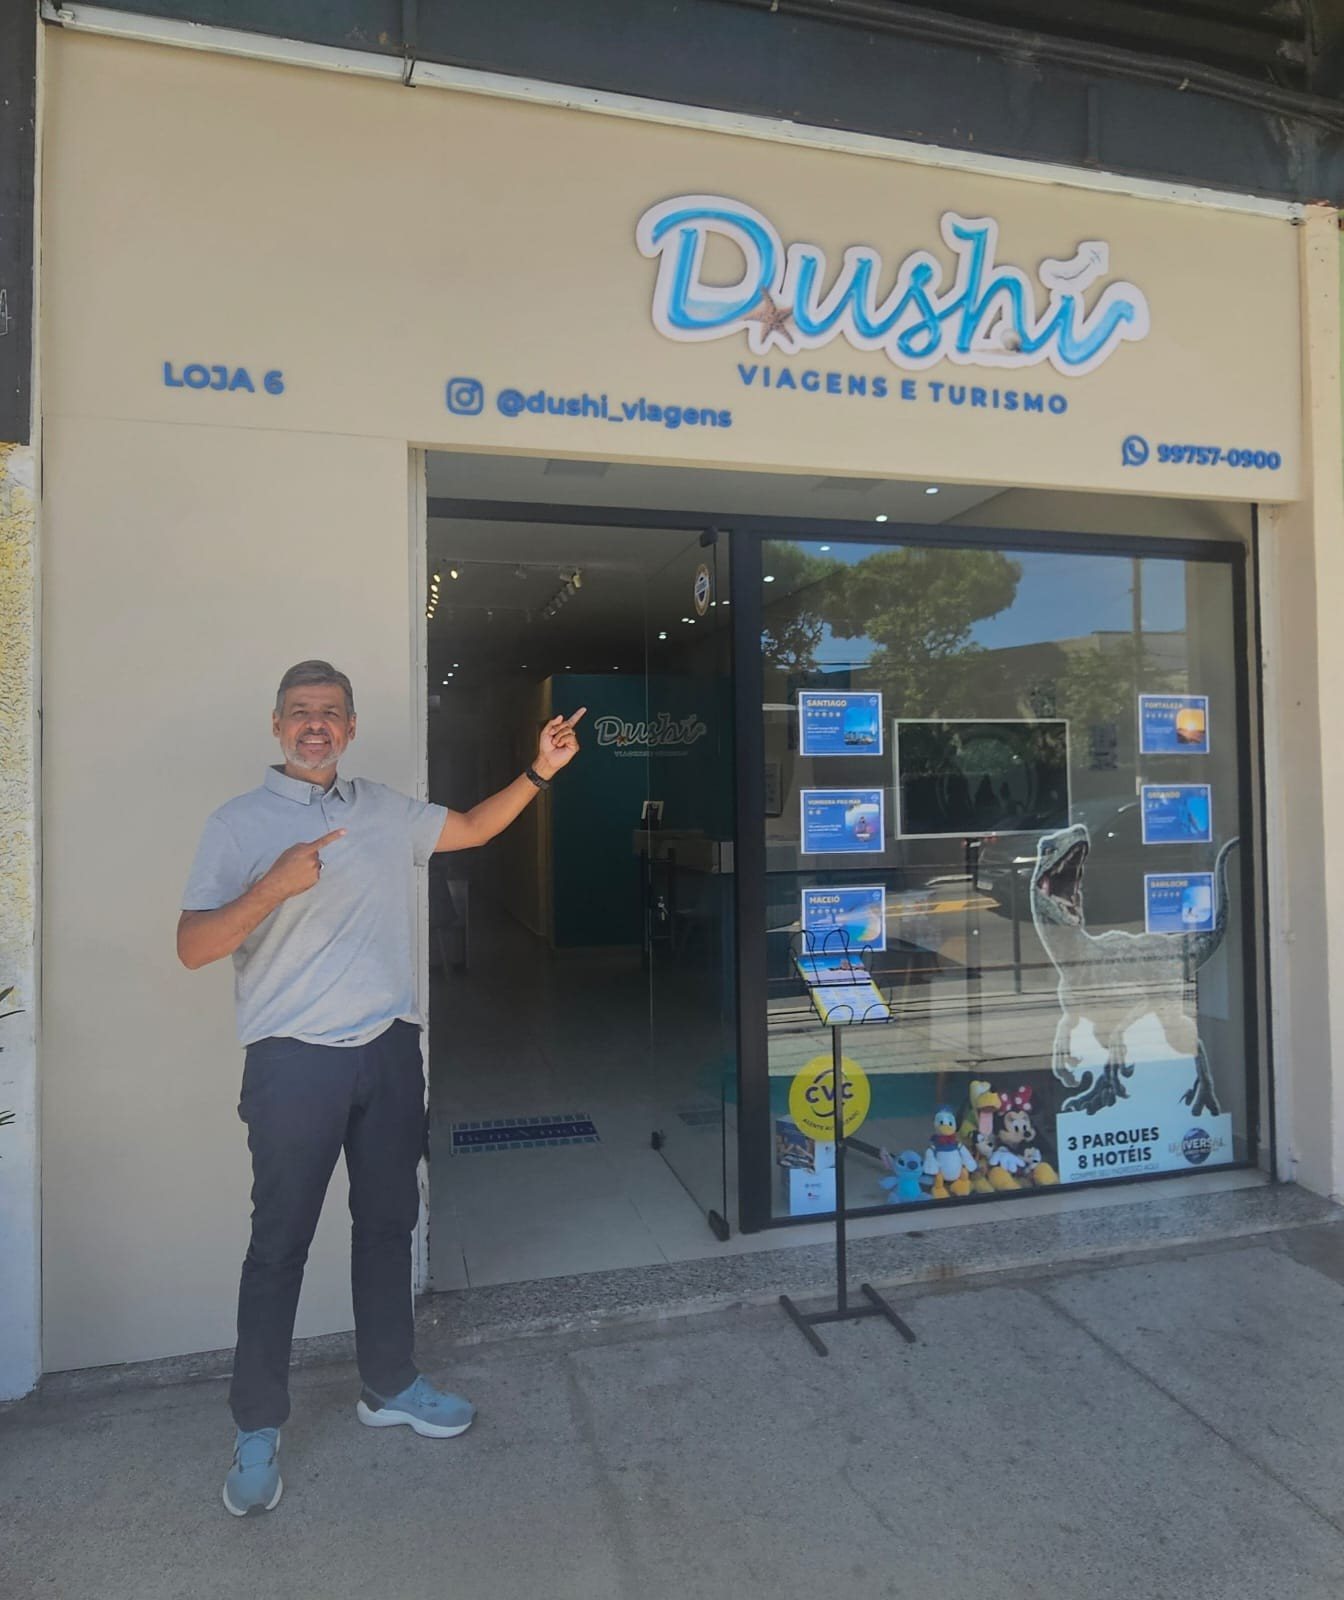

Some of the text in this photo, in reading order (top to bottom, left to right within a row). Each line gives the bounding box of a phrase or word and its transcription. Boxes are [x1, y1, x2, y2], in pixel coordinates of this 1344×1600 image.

[648, 206, 1138, 367] Dushi
[163, 361, 285, 395] LOJA 6
[737, 363, 1068, 415] VIAGENS E TURISMO
[496, 388, 733, 430] @dushi_viagens
[1157, 443, 1282, 470] 99757-0900
[806, 699, 848, 708] SANTIAGO
[805, 1082, 854, 1104] CVC
[1067, 1126, 1160, 1151] 3 PARQUES
[1078, 1145, 1152, 1169] 8 HOTÉIS
